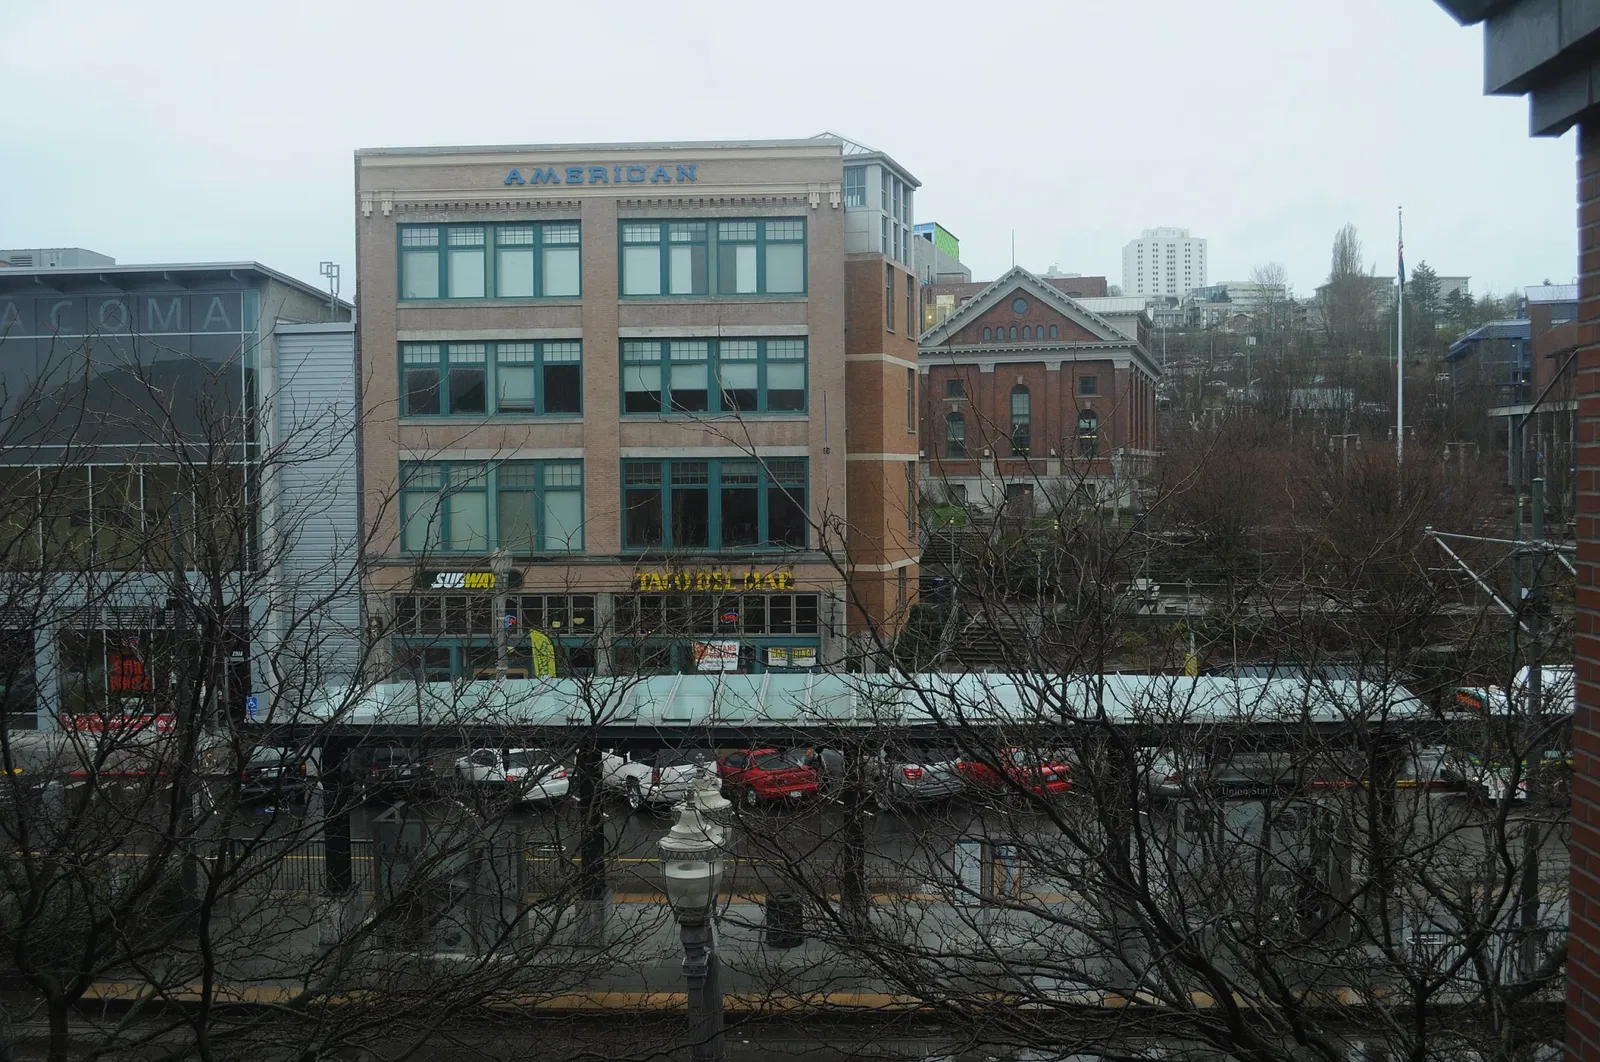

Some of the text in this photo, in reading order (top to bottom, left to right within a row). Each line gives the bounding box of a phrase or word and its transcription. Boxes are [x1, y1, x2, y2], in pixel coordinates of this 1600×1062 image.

[504, 164, 698, 185] AMERICAN
[431, 572, 496, 589] SUBWAY
[636, 571, 794, 592] TACO DEL MAR
[791, 648, 814, 658] IRING!
[1251, 786, 1281, 795] Statio
